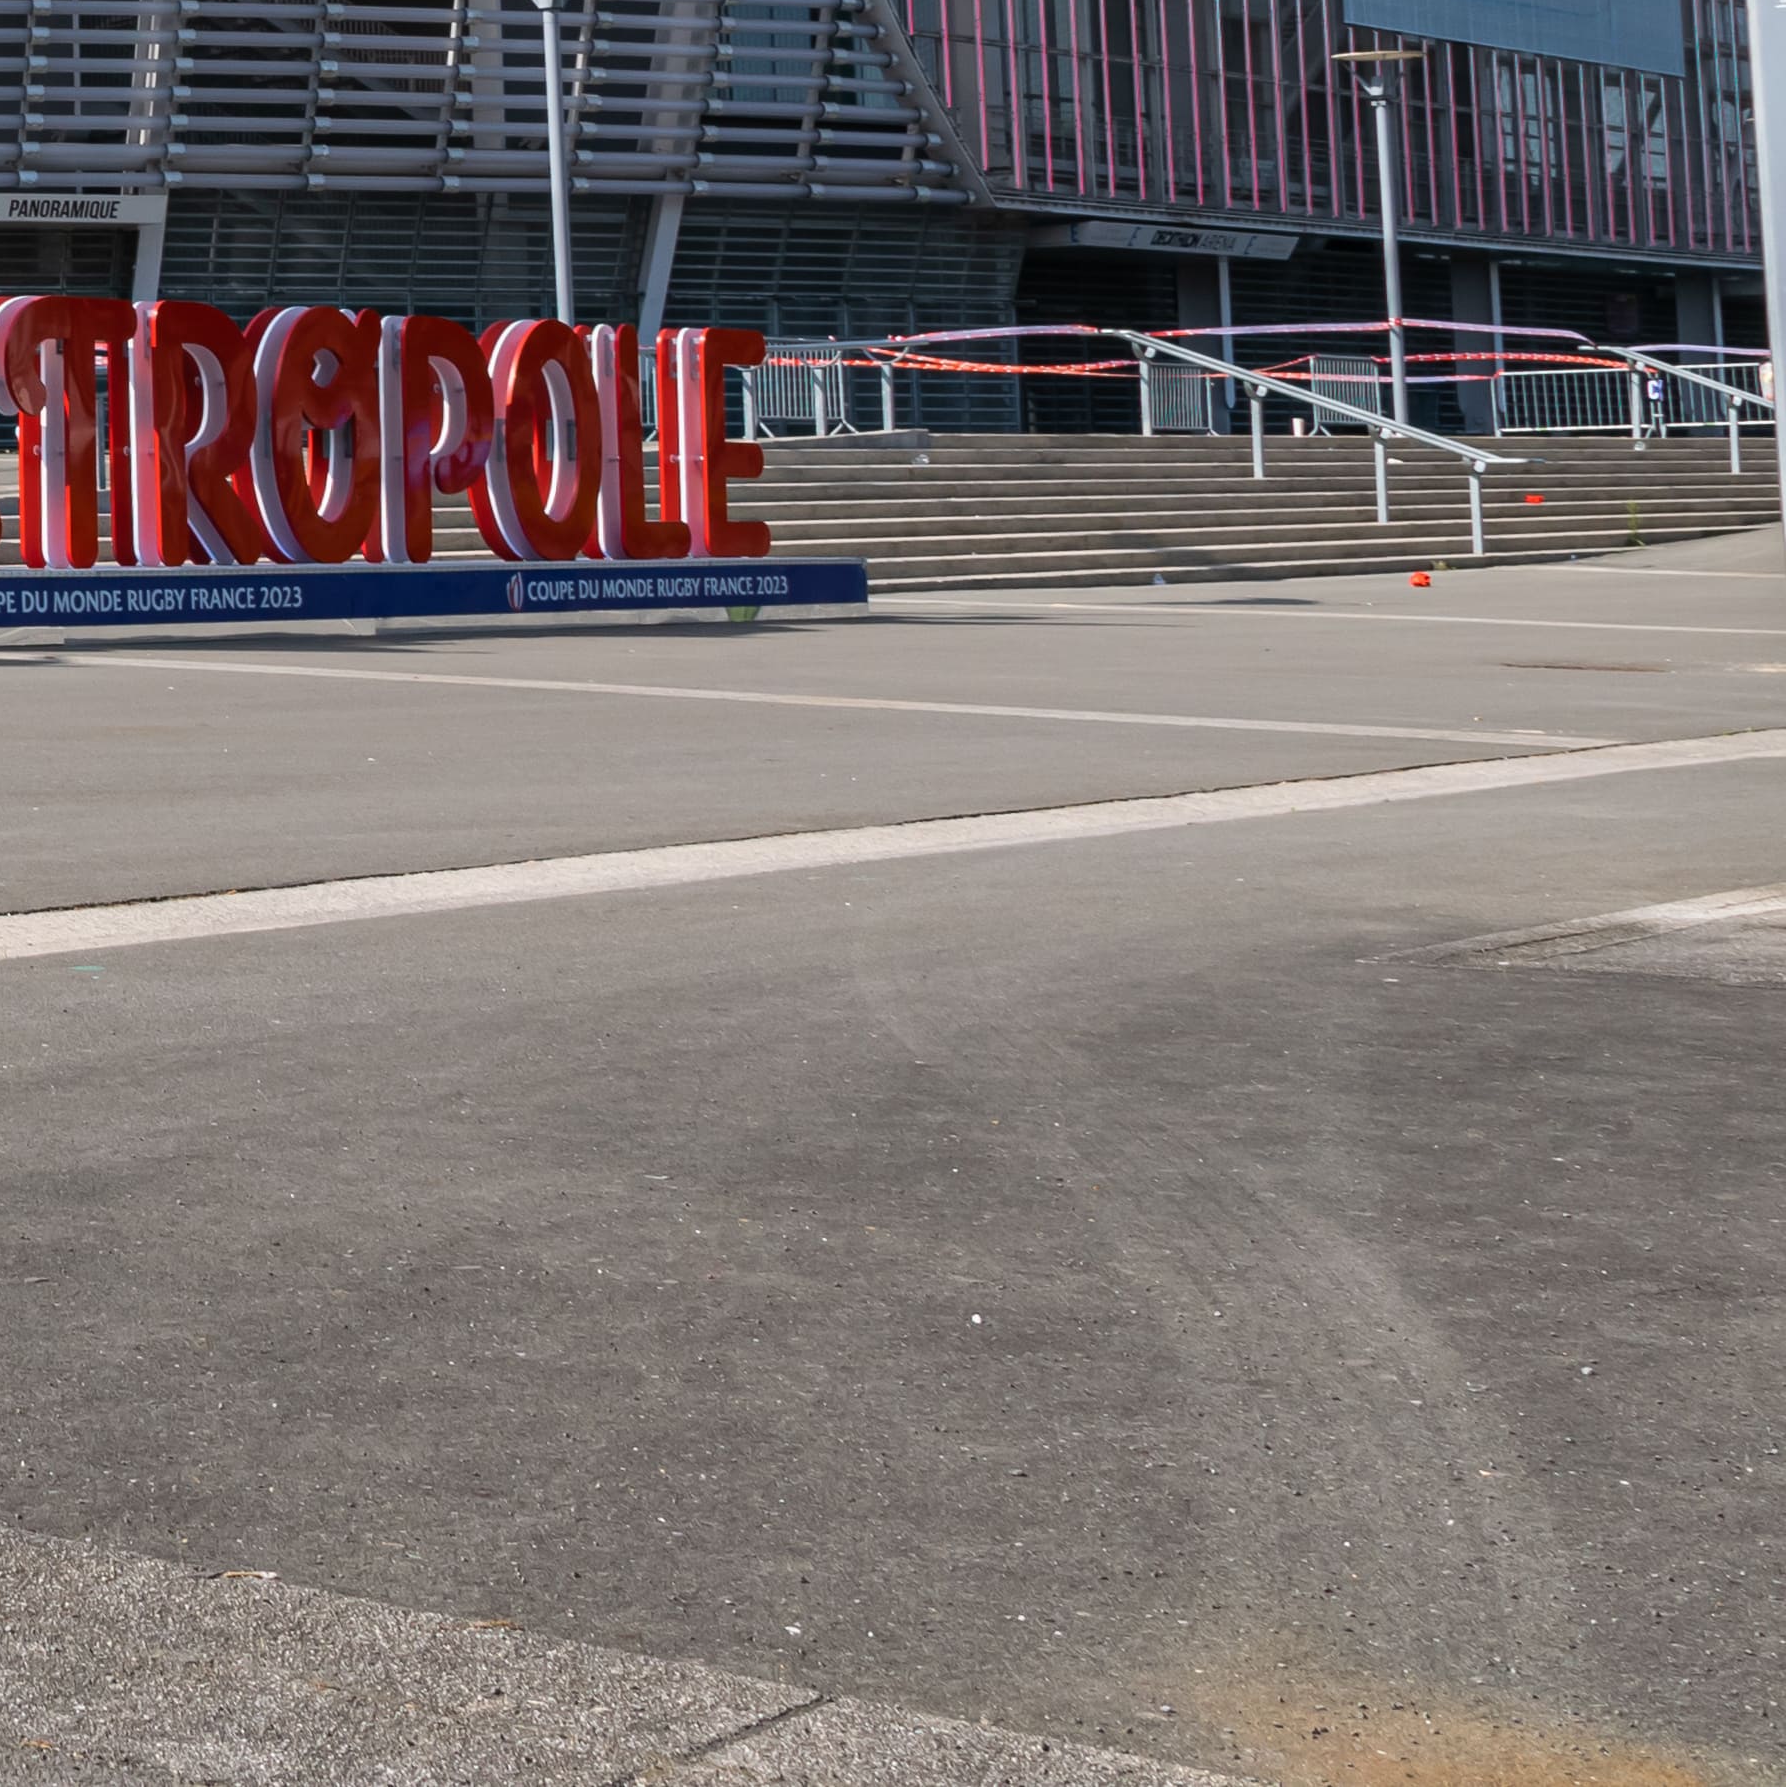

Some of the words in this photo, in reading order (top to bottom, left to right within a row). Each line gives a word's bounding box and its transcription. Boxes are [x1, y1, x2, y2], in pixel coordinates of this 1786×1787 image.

[9, 199, 120, 219] PANORAMIQUE
[21, 590, 48, 613] DU
[53, 588, 123, 613] MONDE
[127, 588, 186, 612] RUGBY
[190, 587, 257, 610] FRANCE
[260, 586, 302, 608] 2023
[528, 581, 576, 601] COUPE
[579, 580, 600, 599] DU
[602, 578, 655, 599] MONDE
[657, 577, 701, 598] RUGBY
[704, 576, 754, 597] FRANCE
[757, 575, 788, 595] 2023
